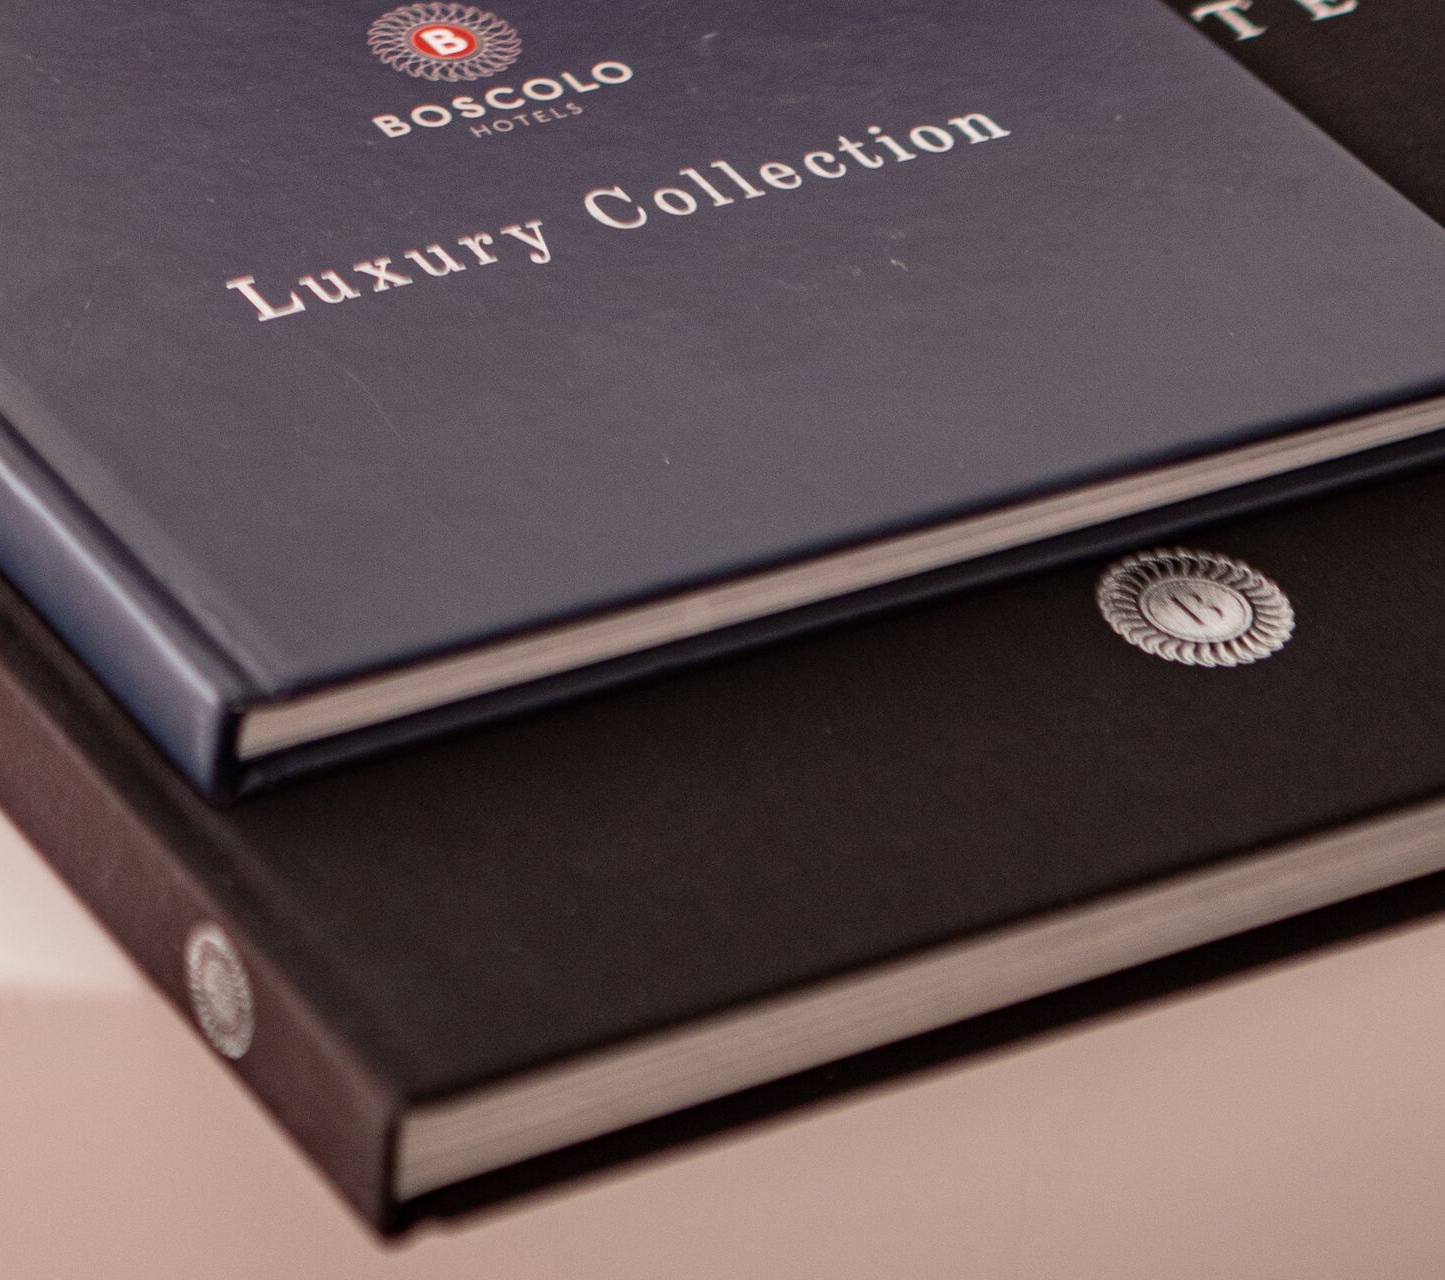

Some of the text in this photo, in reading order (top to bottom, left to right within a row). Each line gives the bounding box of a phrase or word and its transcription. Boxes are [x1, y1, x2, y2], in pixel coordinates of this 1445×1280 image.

[421, 28, 468, 56] B
[371, 60, 634, 139] BOSCOLO
[469, 101, 584, 139] HOTELS
[226, 102, 1012, 323] Luxury Collection
